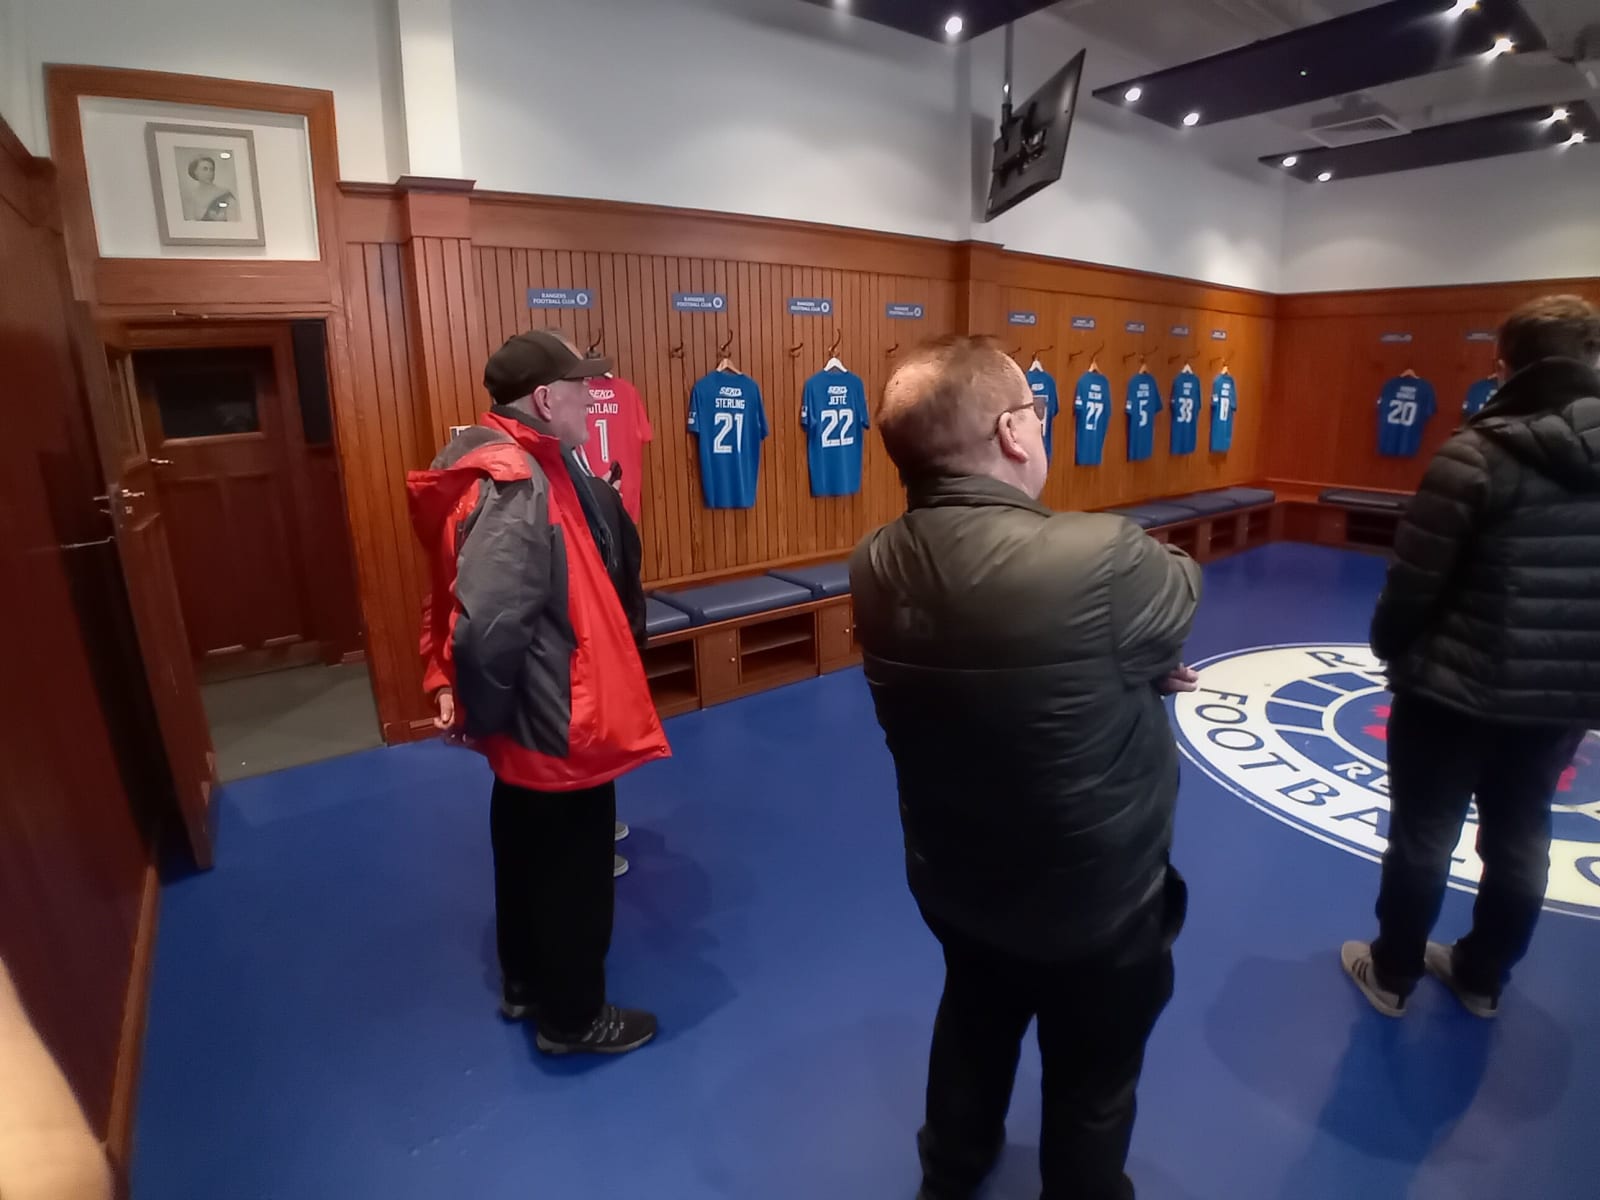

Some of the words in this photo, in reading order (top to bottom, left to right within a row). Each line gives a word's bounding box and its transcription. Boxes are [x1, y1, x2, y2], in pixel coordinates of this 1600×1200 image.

[586, 402, 618, 414] UTLAND
[715, 397, 745, 410] STERLING
[1085, 400, 1104, 431] 27
[1139, 399, 1149, 427] 5
[1387, 399, 1418, 427] 20
[595, 419, 609, 463] 1
[713, 412, 744, 454] 21
[821, 408, 854, 448] 22
[1195, 686, 1465, 863] FOOTBA
